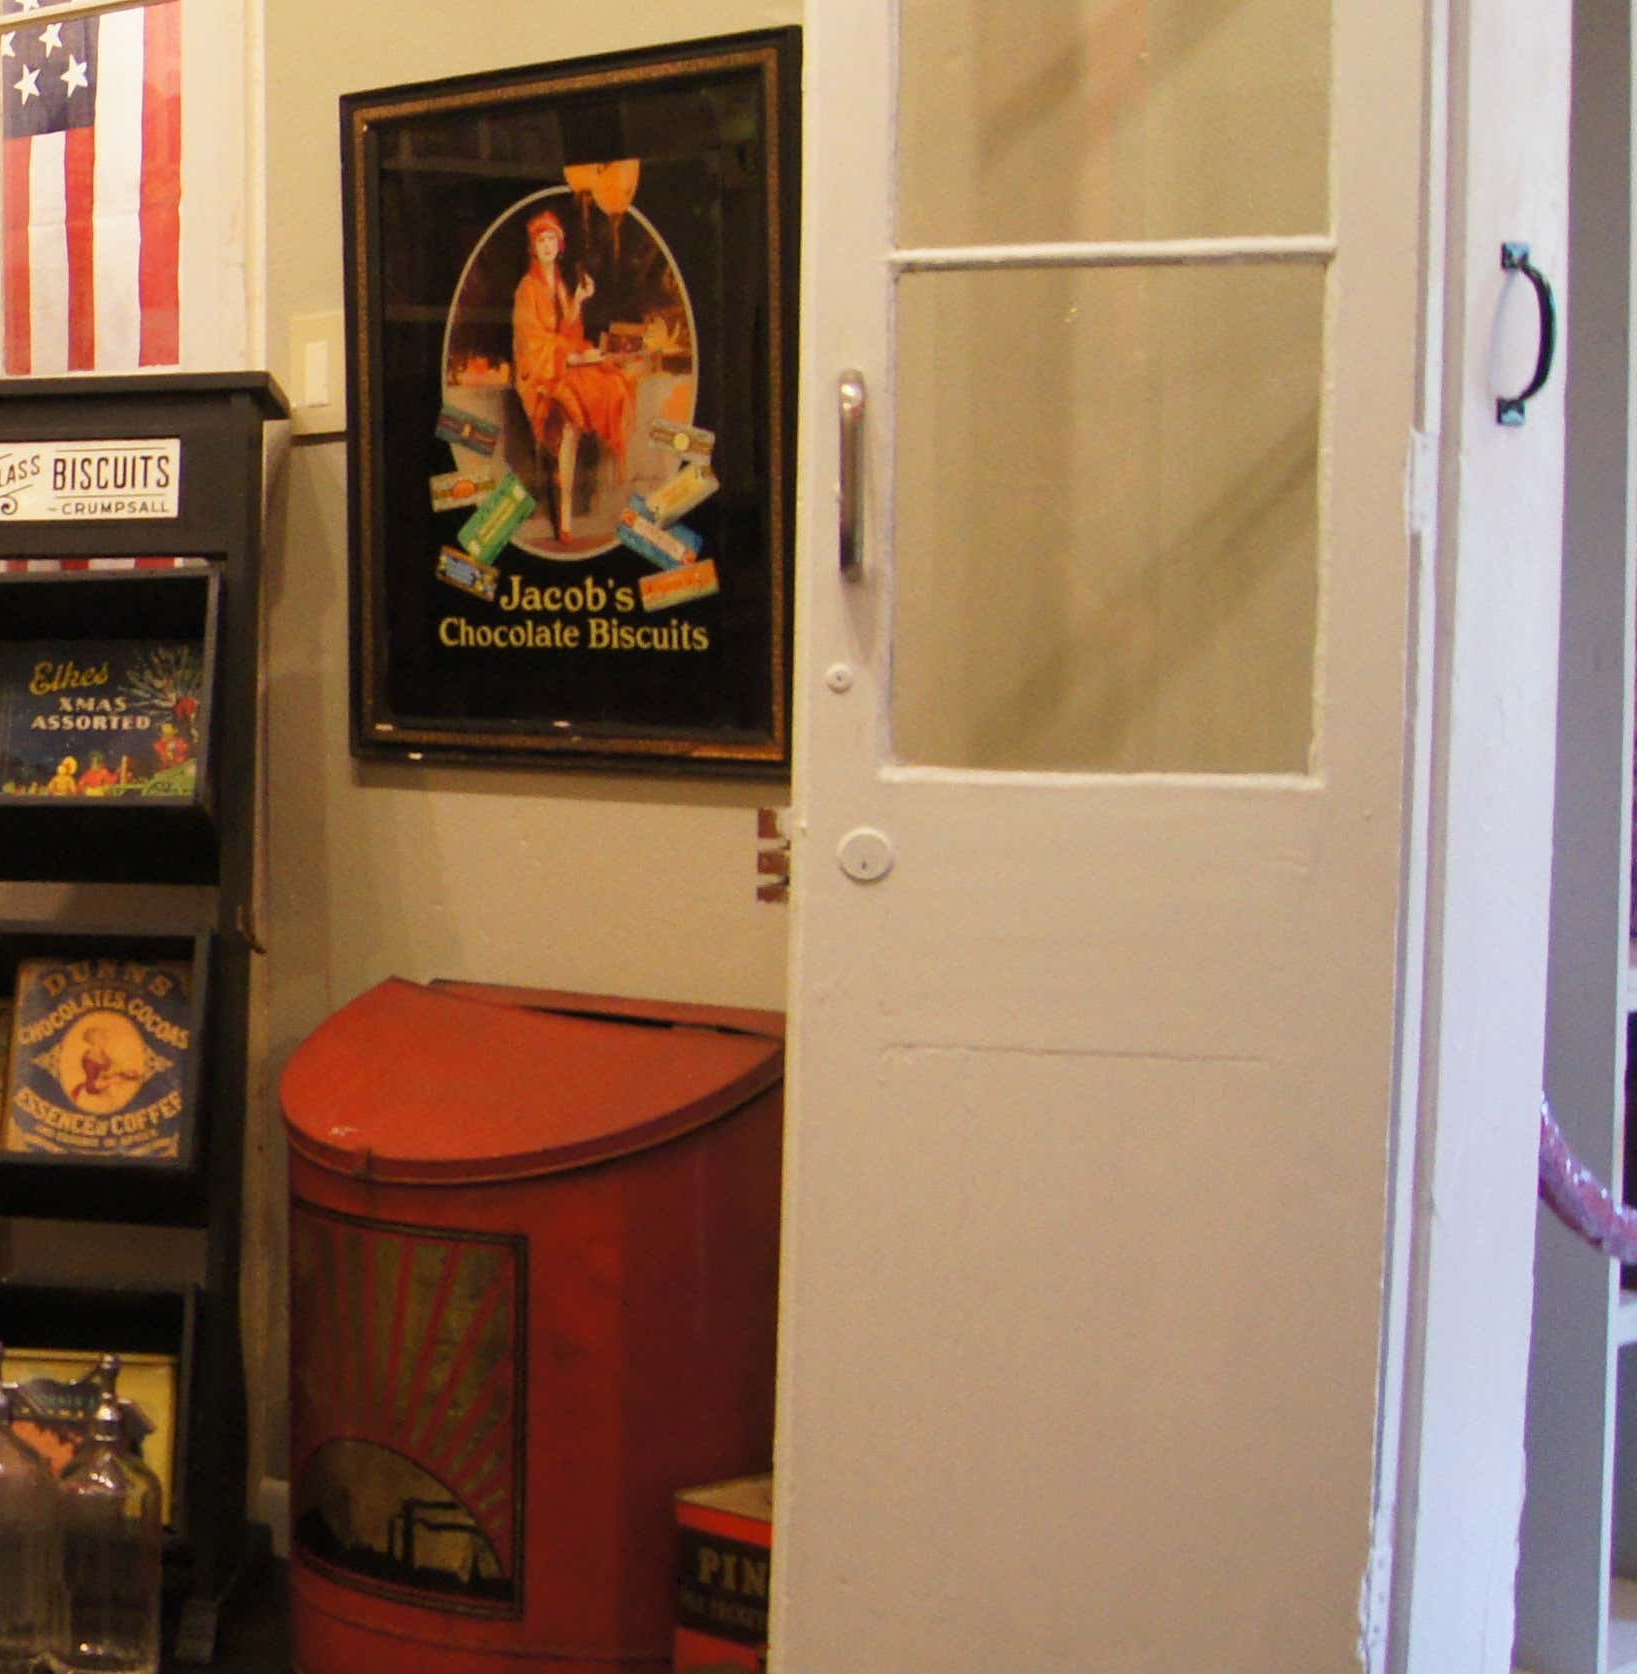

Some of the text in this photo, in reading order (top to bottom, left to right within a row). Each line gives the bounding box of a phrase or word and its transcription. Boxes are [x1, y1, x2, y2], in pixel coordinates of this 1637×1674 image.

[52, 453, 171, 492] BISCUITS
[498, 573, 636, 613] Jacob's
[438, 615, 710, 652] Chocolate Biscuits
[29, 714, 152, 732] ASSORTED
[57, 696, 128, 714] XMAS
